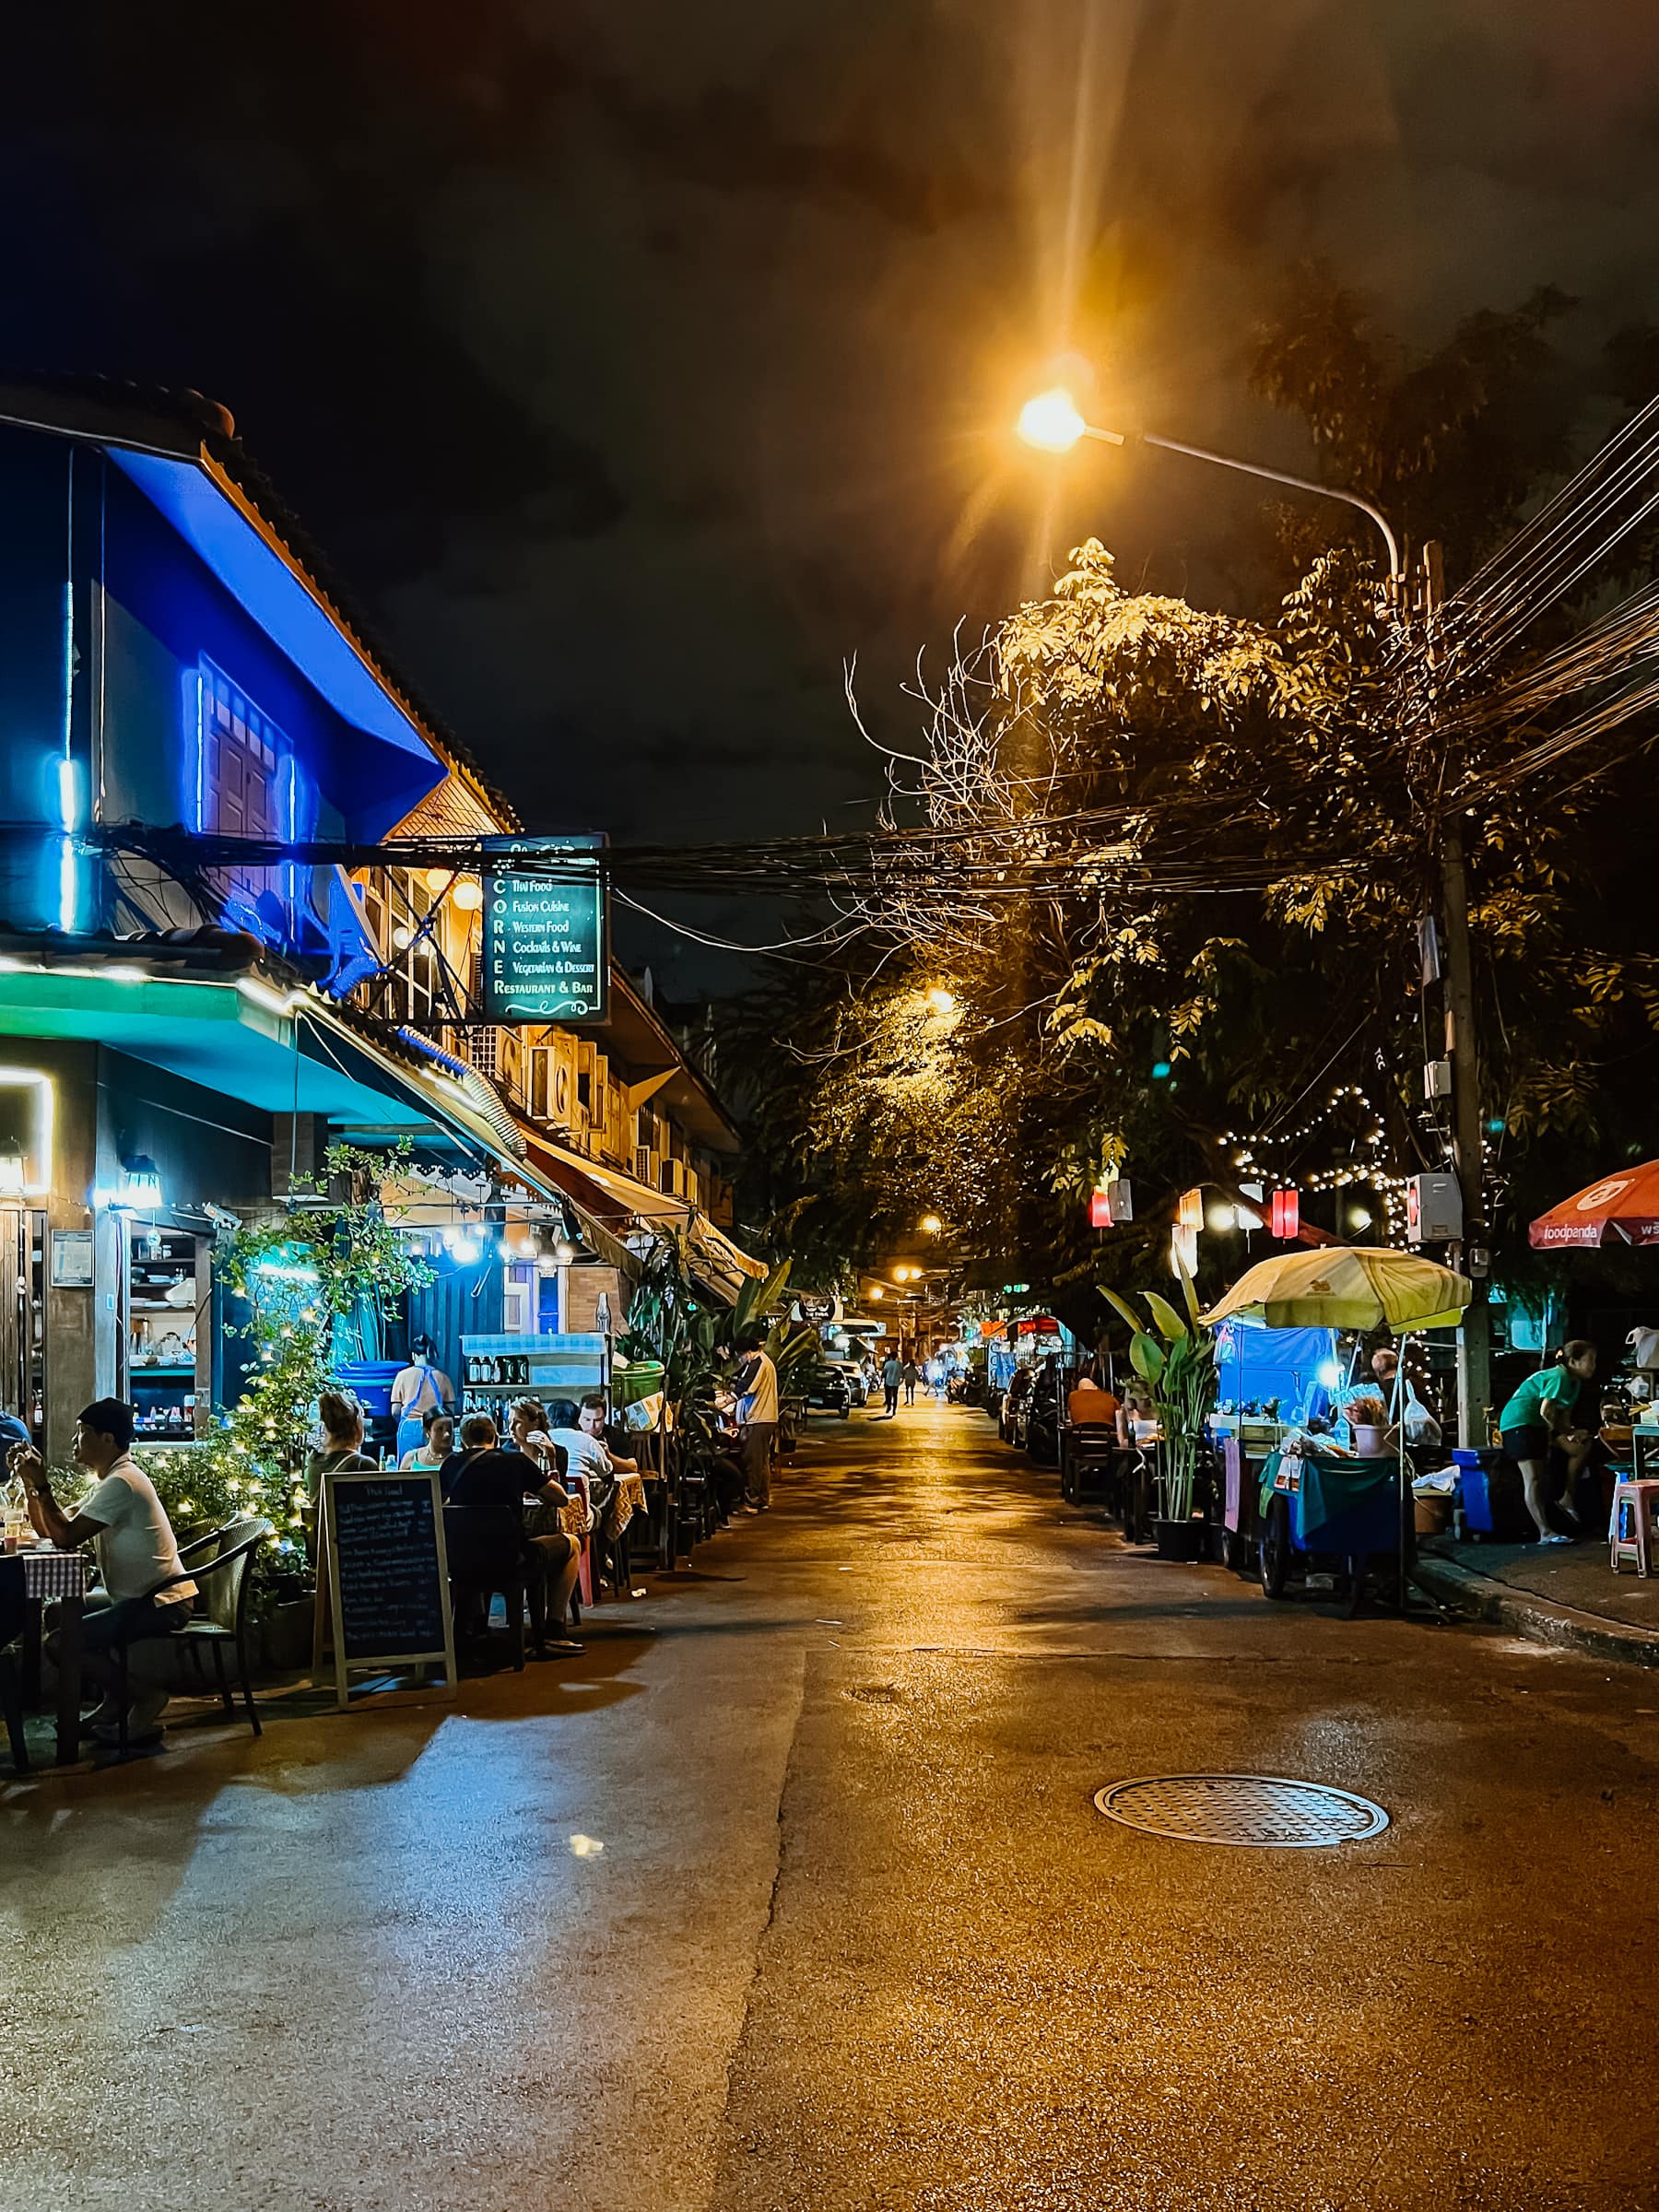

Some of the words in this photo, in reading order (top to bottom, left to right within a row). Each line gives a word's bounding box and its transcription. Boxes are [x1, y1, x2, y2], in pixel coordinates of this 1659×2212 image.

[552, 940, 560, 953] &
[555, 960, 564, 973] &
[559, 981, 569, 994] &
[1544, 1224, 1597, 1242] foodpanda
